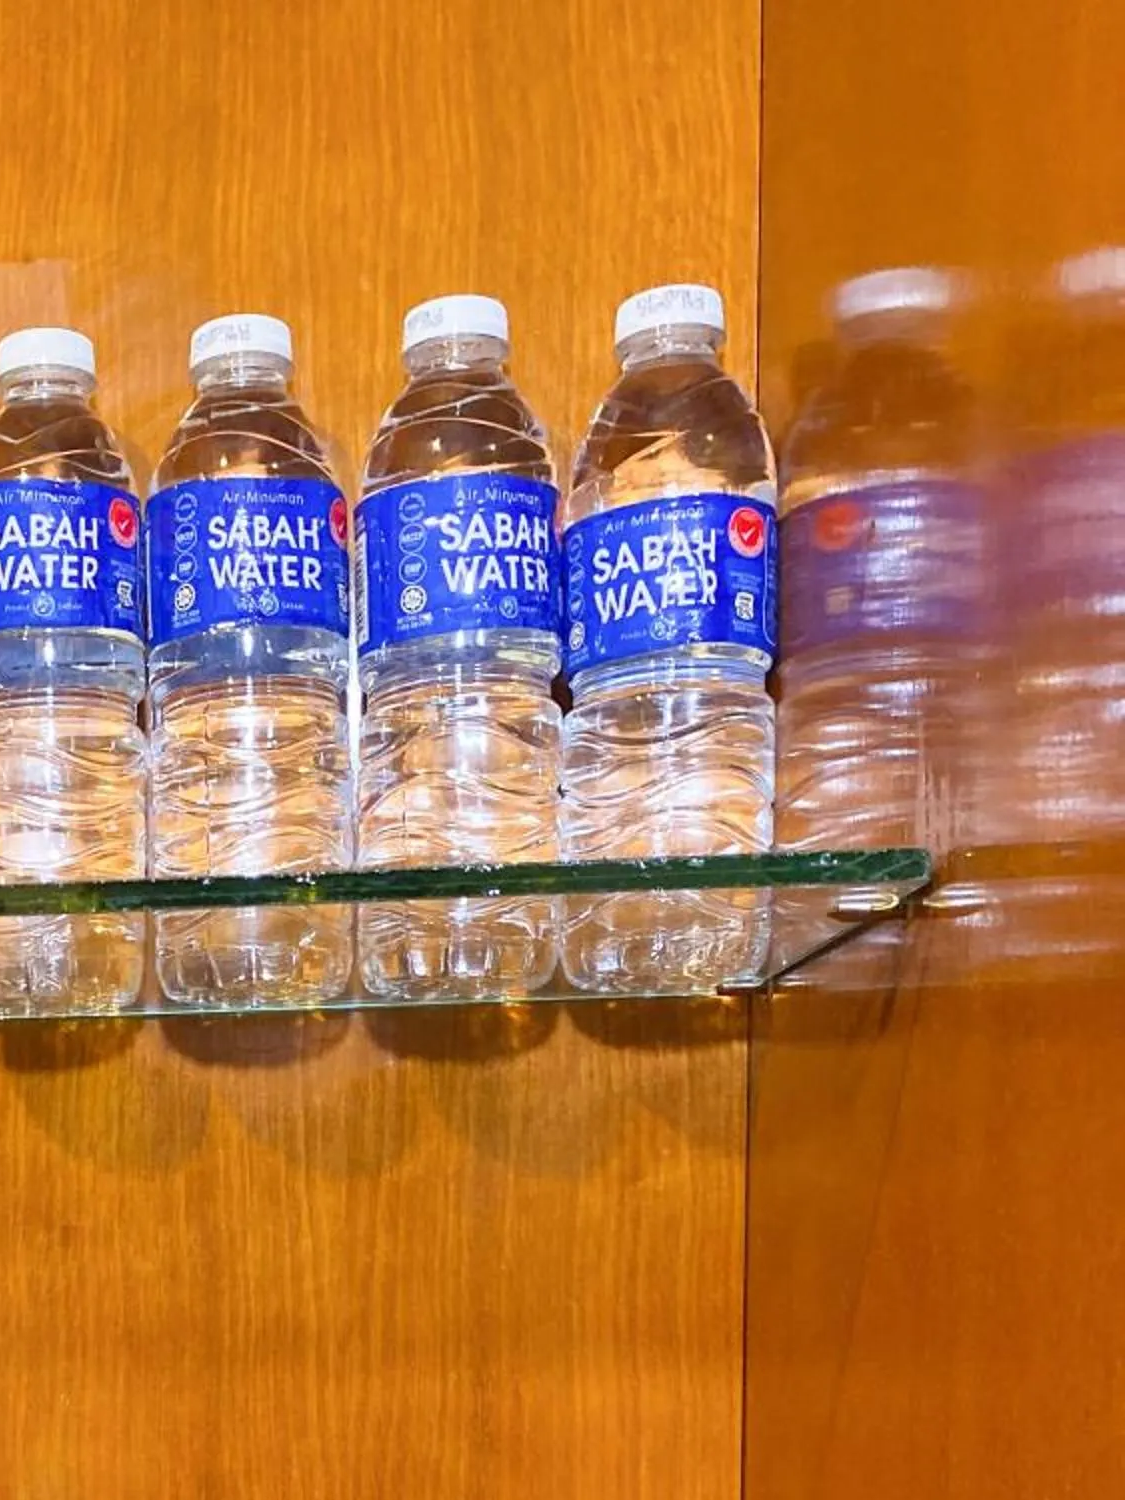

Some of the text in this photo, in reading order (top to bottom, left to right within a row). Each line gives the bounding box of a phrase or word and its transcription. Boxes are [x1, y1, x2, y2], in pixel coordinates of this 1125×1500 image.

[222, 491, 304, 505] Air Minuman
[455, 487, 478, 502] Air
[207, 514, 320, 551] SABAH
[438, 511, 549, 553] SABAH
[208, 554, 322, 591] WATER
[440, 554, 550, 595] WATER
[592, 528, 716, 585] SABAH
[594, 569, 718, 625] WATER
